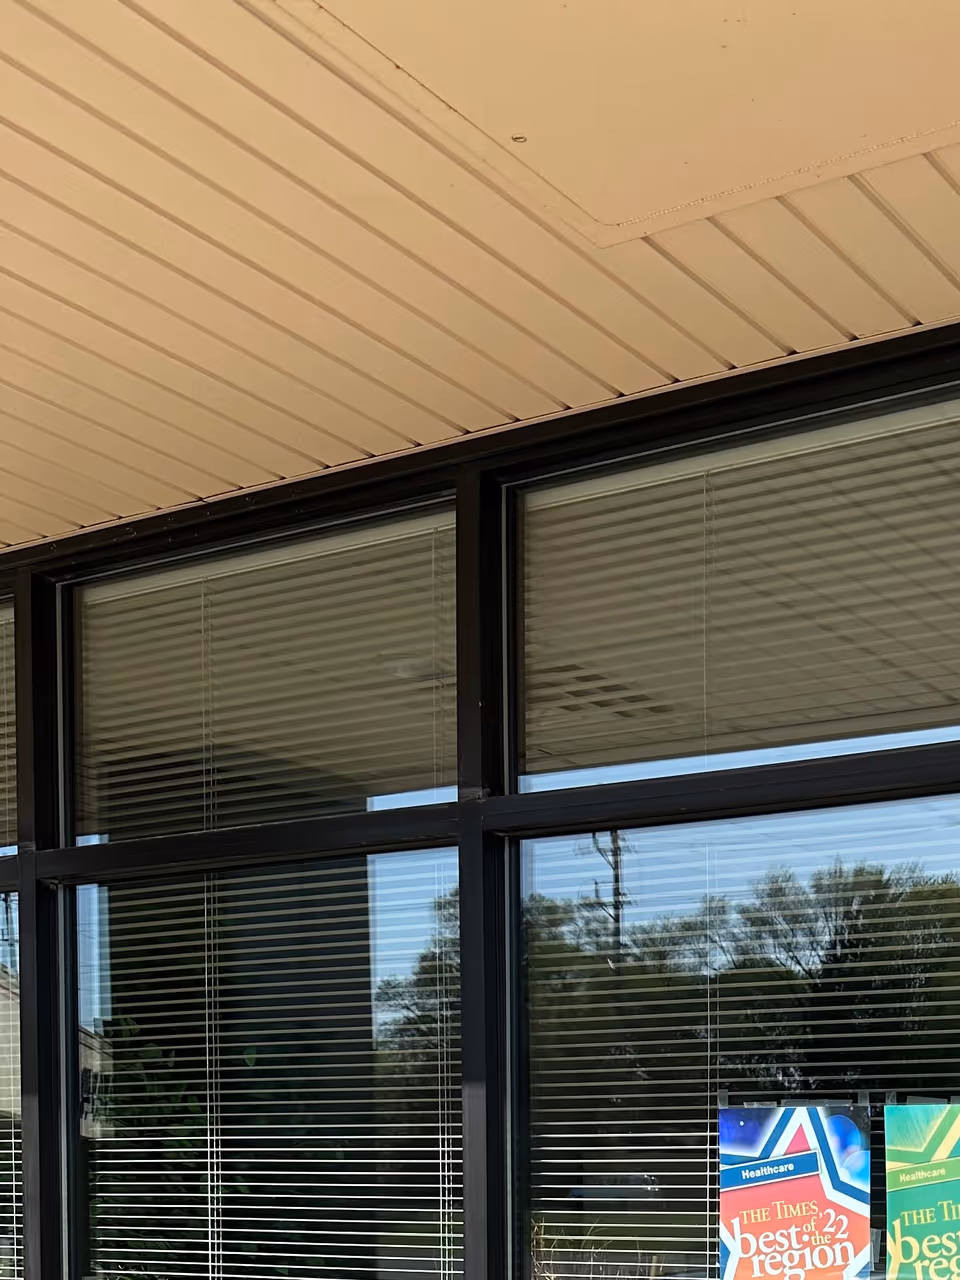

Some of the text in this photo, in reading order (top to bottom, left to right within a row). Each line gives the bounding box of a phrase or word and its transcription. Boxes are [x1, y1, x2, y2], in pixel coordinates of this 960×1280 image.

[741, 1162, 795, 1180] Healthcare
[899, 1167, 947, 1184] Healthcare
[739, 1199, 819, 1226] THE TIMES
[901, 1207, 937, 1227] THE
[731, 1217, 803, 1259] best
[803, 1216, 817, 1233] of
[811, 1230, 832, 1246] the
